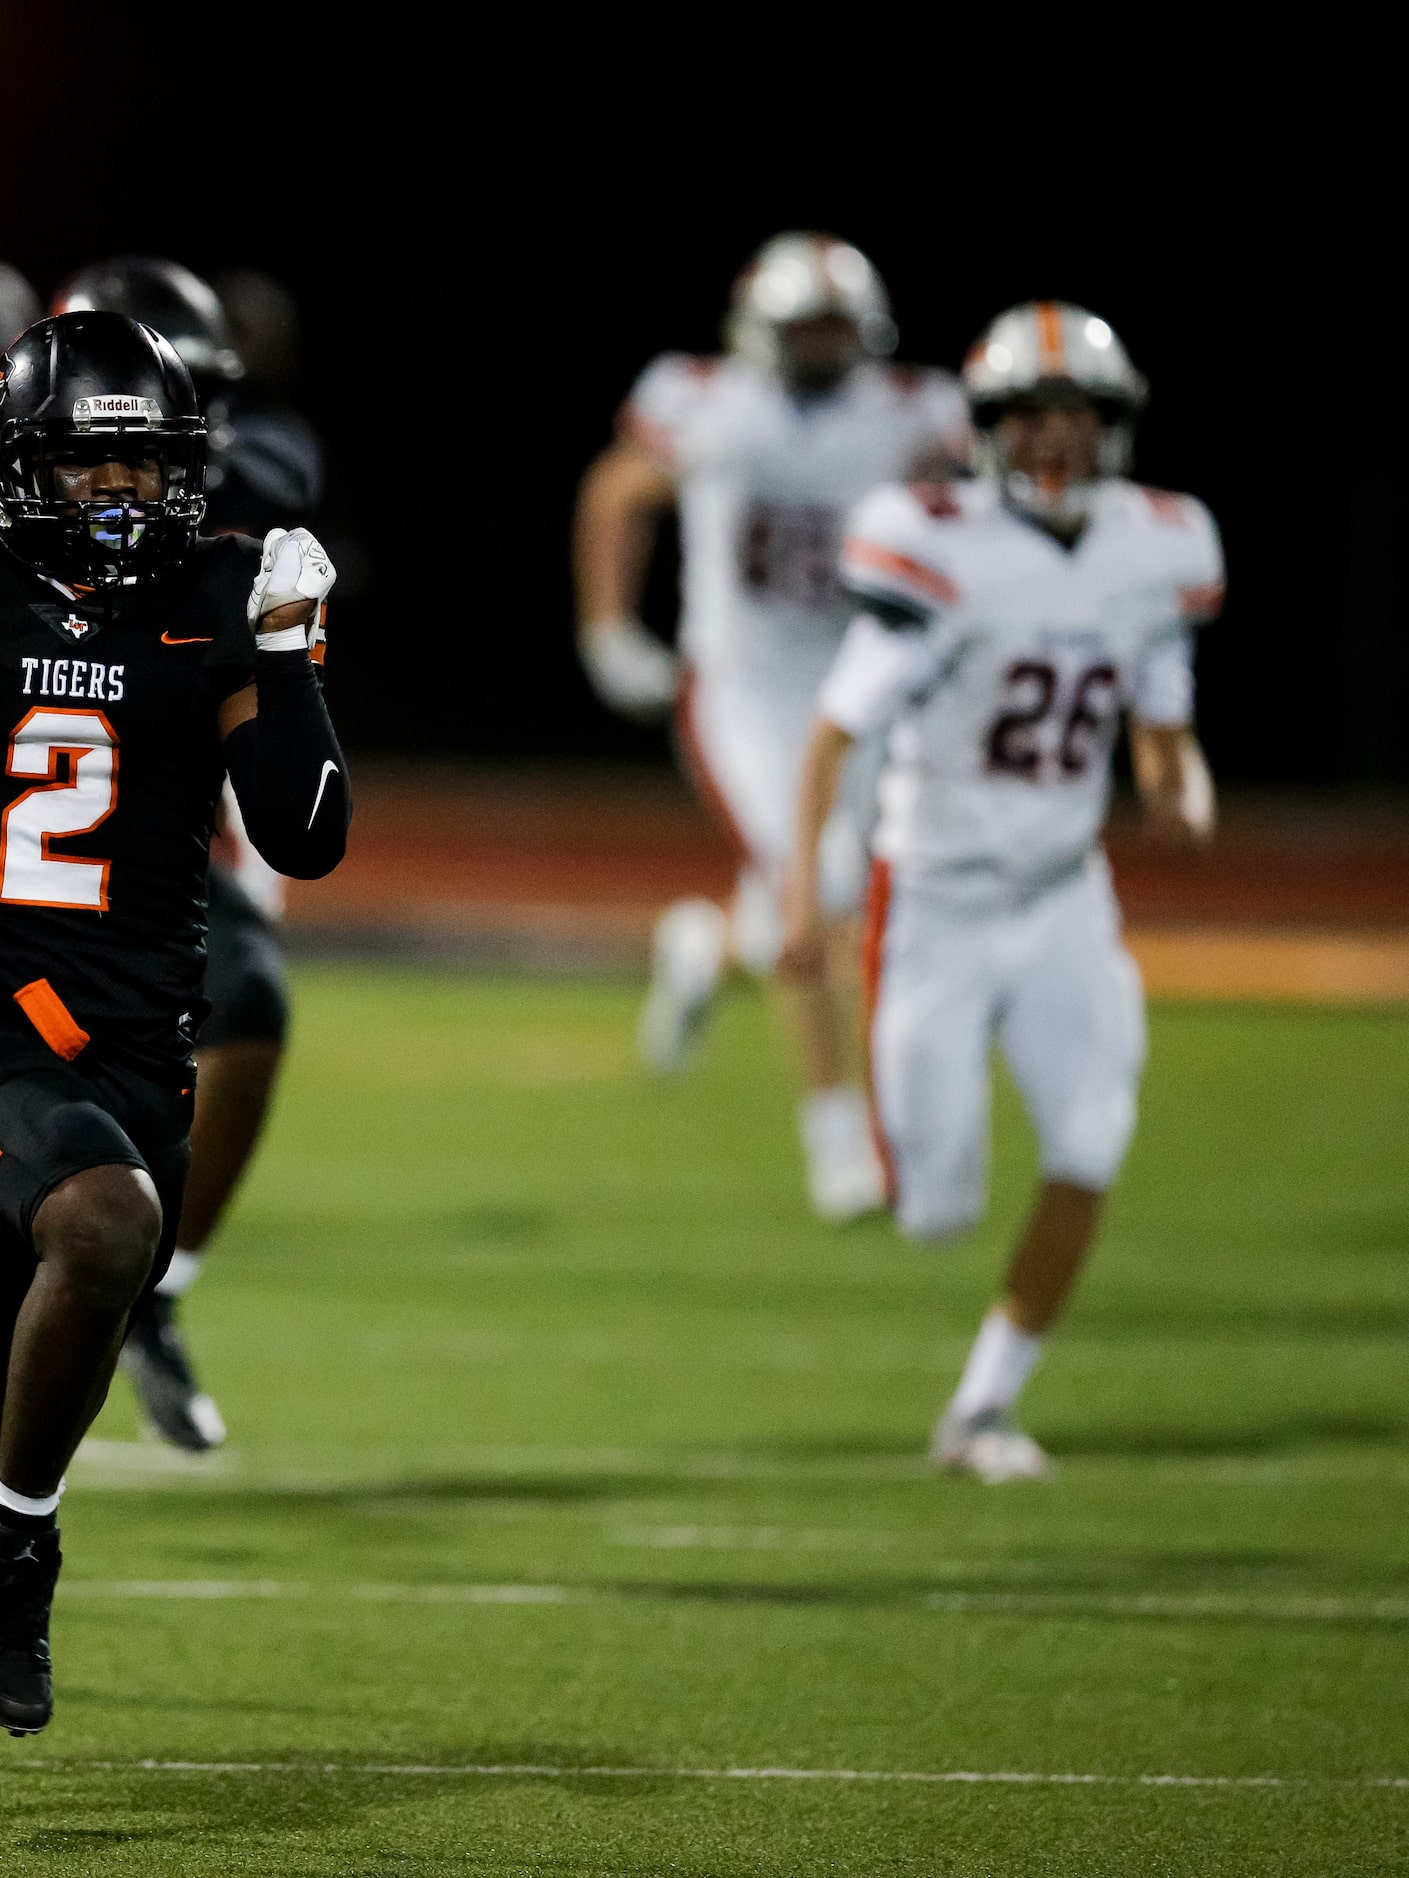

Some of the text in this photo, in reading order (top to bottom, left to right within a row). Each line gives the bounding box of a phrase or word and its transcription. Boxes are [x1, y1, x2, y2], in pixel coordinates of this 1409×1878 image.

[93, 398, 138, 412] Riddell
[21, 656, 124, 701] TIGERS
[980, 656, 1120, 782] 26
